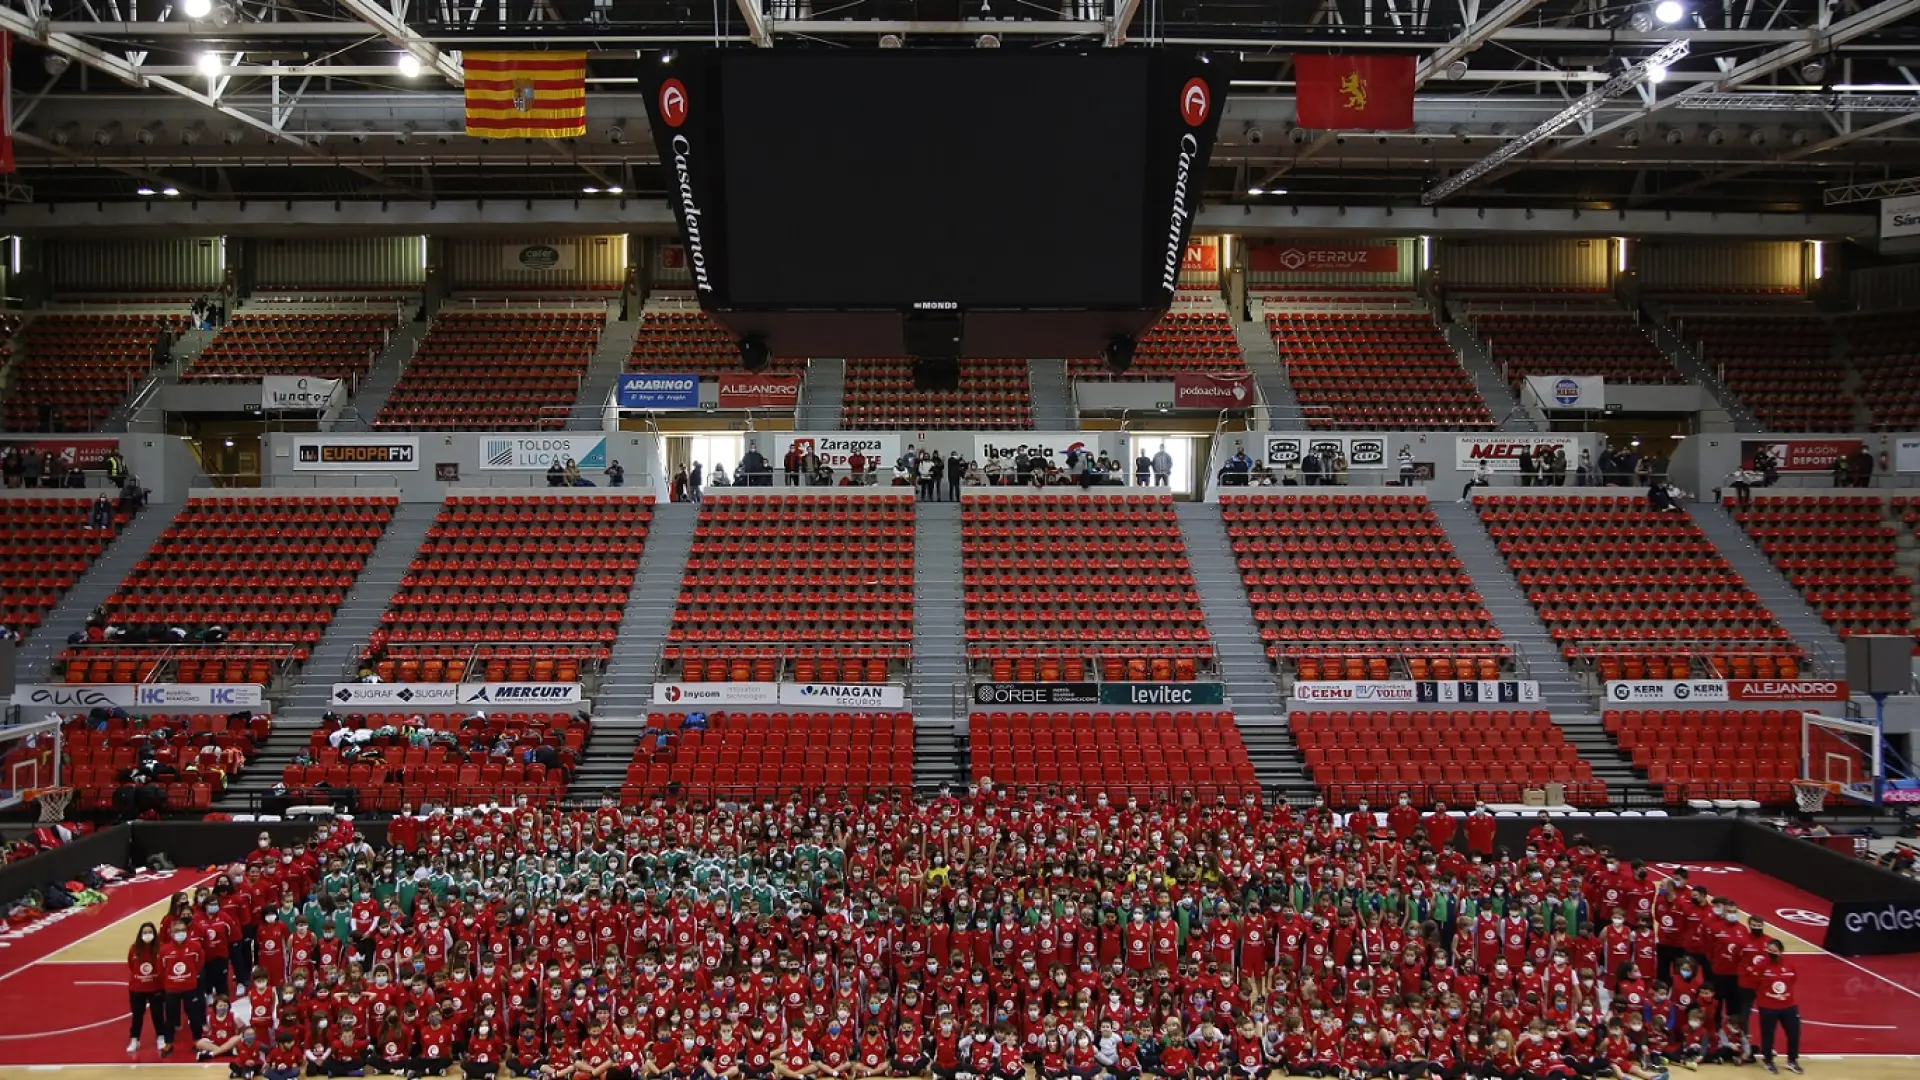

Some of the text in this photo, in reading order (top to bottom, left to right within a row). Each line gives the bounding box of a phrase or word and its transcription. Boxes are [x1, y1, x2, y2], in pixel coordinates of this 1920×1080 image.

[671, 134, 713, 293] Casademont
[1162, 132, 1198, 293] Casademont
[1308, 251, 1367, 263] FERRUZ
[922, 302, 958, 310] MONDO
[624, 380, 694, 391] ARABINGO
[720, 385, 798, 395] ALEJANDRO
[1180, 386, 1232, 398] podoactiva
[518, 440, 570, 450] TOLDOS
[820, 438, 882, 453] Zaragoza
[519, 453, 570, 465] LUCAS
[353, 689, 455, 698] SUGRAF SUGRAF
[495, 687, 573, 698] MERCURY
[820, 686, 882, 697] ANAGAN
[1311, 689, 1353, 698] CEMU
[1376, 689, 1412, 698] VOLUM
[1634, 685, 1663, 693] KERN
[1693, 684, 1723, 693] KERN
[1742, 682, 1838, 694] ALEJANDRO
[31, 689, 119, 706] aura
[995, 689, 1047, 702] ORBE
[1131, 685, 1192, 704] levitec
[836, 698, 882, 706] SEGUROS
